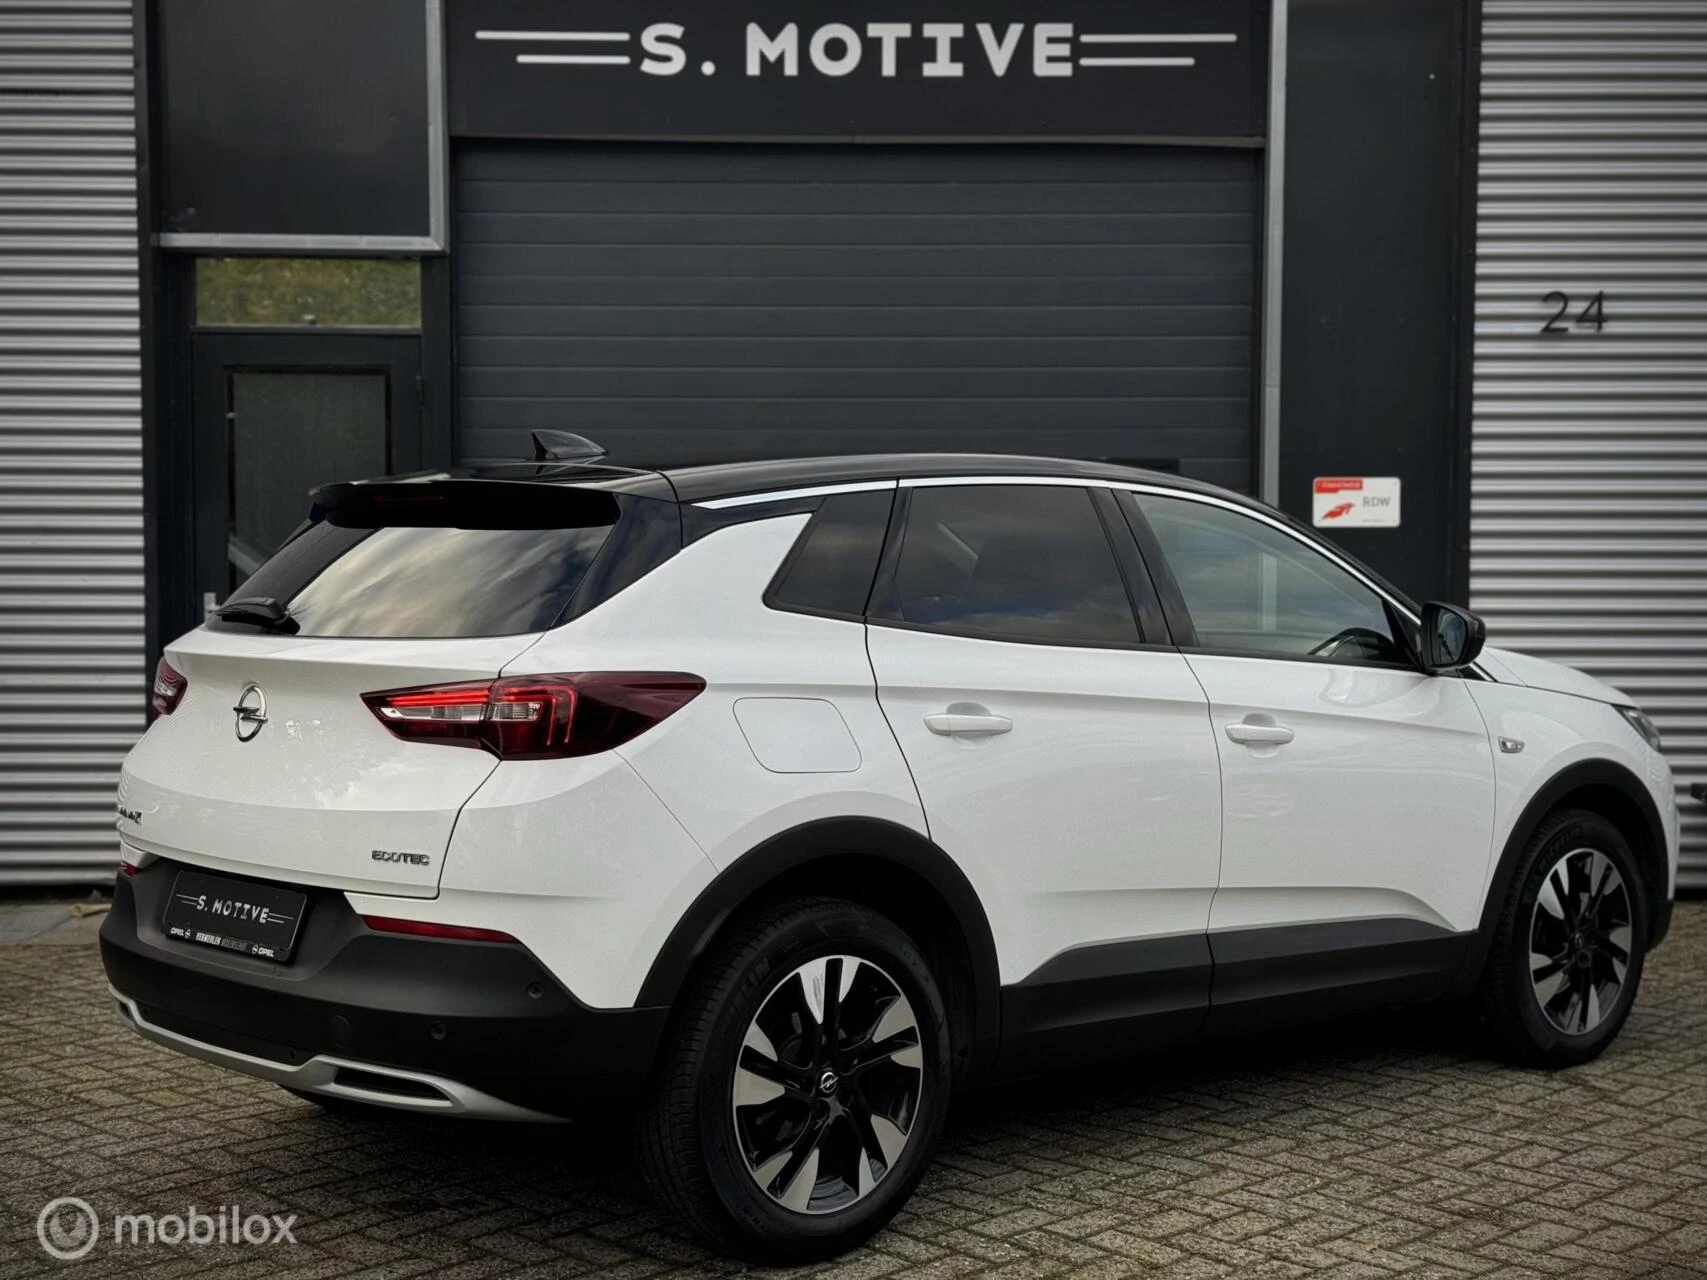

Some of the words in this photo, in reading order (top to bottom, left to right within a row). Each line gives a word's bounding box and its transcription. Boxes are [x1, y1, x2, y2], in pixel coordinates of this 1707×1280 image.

[639, 22, 715, 77] S.
[746, 22, 1074, 78] MOTIVE
[1540, 289, 1609, 333] 24
[1362, 496, 1392, 508] RDW
[371, 850, 431, 866] ECOTEC
[196, 895, 209, 912] S.
[211, 898, 270, 924] MOTIVE
[170, 926, 185, 937] OPEL
[258, 947, 275, 958] OPEL
